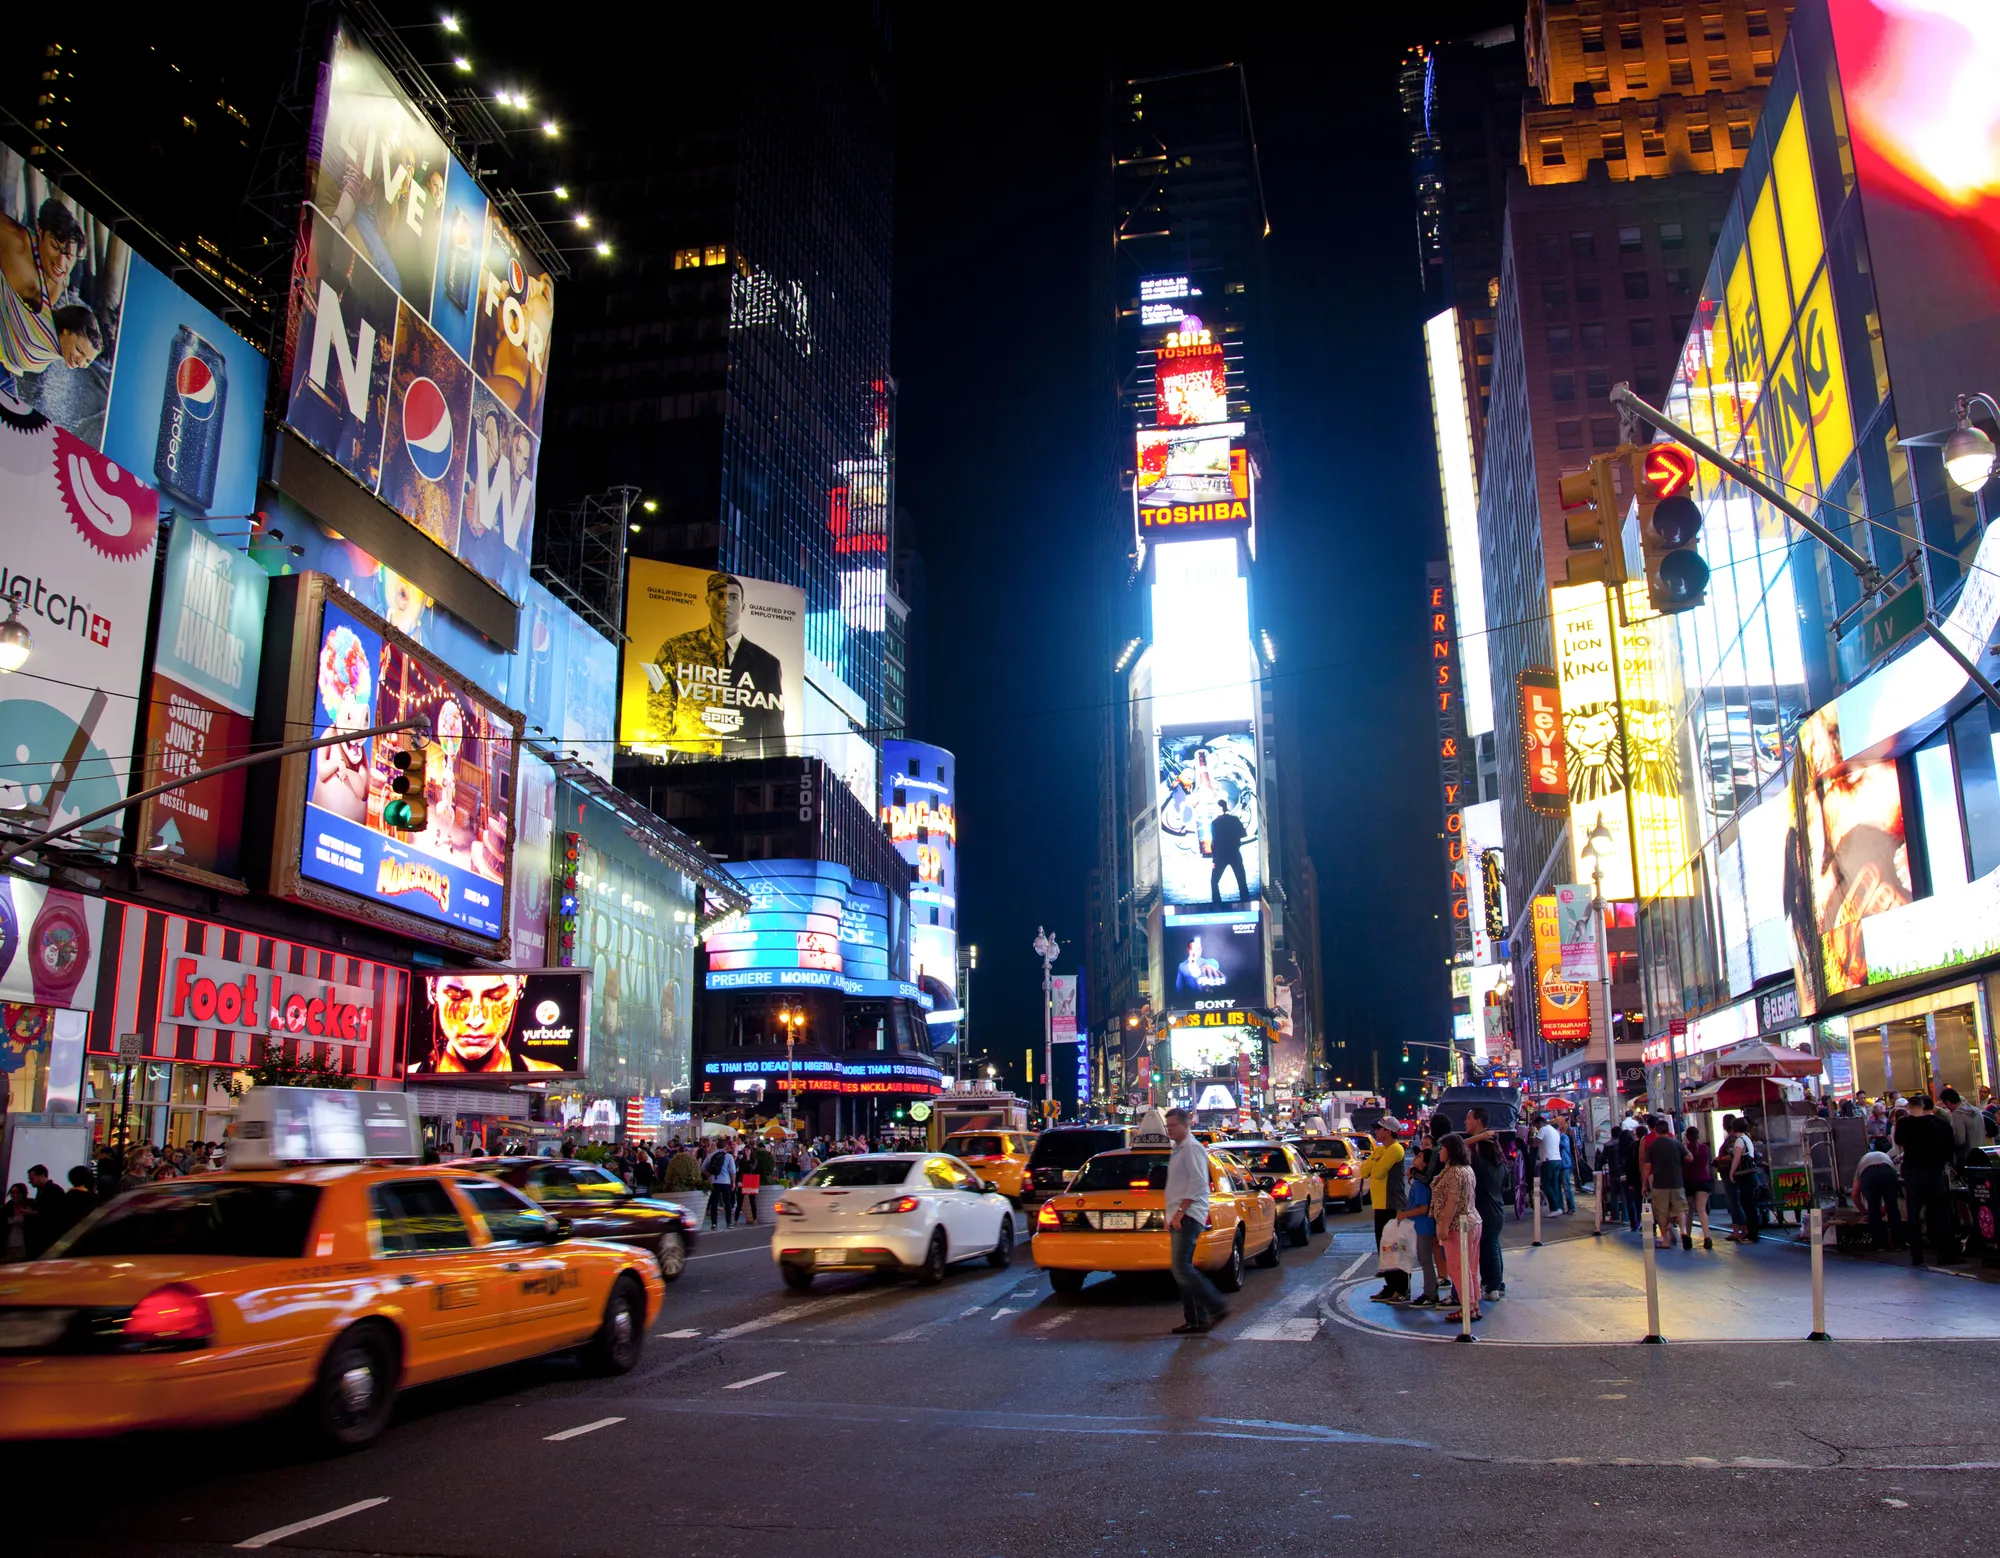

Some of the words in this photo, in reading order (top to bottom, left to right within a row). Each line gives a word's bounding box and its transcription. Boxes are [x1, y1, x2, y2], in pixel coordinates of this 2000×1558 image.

[485, 271, 543, 374] FOR
[1166, 329, 1212, 348] 2012
[1156, 343, 1223, 359] TOSHIBA
[167, 405, 183, 474] pepsi
[1140, 501, 1247, 527] TOSHIBA
[183, 557, 235, 632] MOVIE
[647, 586, 683, 598] QUALIFIED
[683, 592, 698, 600] FOR
[649, 593, 696, 606] DEPLOYMENT.
[749, 603, 782, 614] QUALIFIED
[783, 608, 797, 616] FOR
[750, 611, 796, 623] EMPLOYMENT.
[1566, 619, 1595, 633] THE
[174, 605, 245, 690] AWARDS
[1431, 587, 1452, 711] ERNST
[677, 662, 733, 687] HIRE
[737, 671, 756, 690] A
[676, 680, 785, 712] VETERAN
[168, 693, 213, 734] SUNDAY
[701, 711, 744, 726] SPIKE
[165, 721, 196, 754] JUNE
[196, 734, 205, 758] 3
[1442, 738, 1457, 757] &
[162, 747, 188, 778] LIVE
[160, 793, 187, 814] RUSSELL
[188, 803, 209, 821] BRAND
[1445, 784, 1469, 919] YOUNG
[376, 856, 441, 900] MADAGASCAR
[439, 876, 450, 913] 3
[1232, 923, 1256, 931] SONY
[712, 971, 773, 987] PREMIERE
[780, 971, 831, 985] MONDAY
[1195, 1000, 1235, 1010] SONY
[1204, 1012, 1224, 1026] ALL
[1227, 1012, 1245, 1025] ITS
[1543, 1021, 1588, 1030] RESTAURANT
[721, 1062, 742, 1073] THAN
[743, 1062, 759, 1072] 150
[760, 1061, 789, 1072] DEAD
[792, 1061, 802, 1071] IN
[804, 1061, 834, 1072] NIGERIA
[867, 1064, 891, 1074] THAN
[893, 1065, 905, 1074] 150
[1720, 1064, 1742, 1077] NUTS
[1749, 1063, 1771, 1076] NUTS
[808, 1080, 832, 1090] TAKES
[861, 1082, 903, 1093] NICKLAUS
[1778, 1172, 1807, 1188] NUTS
